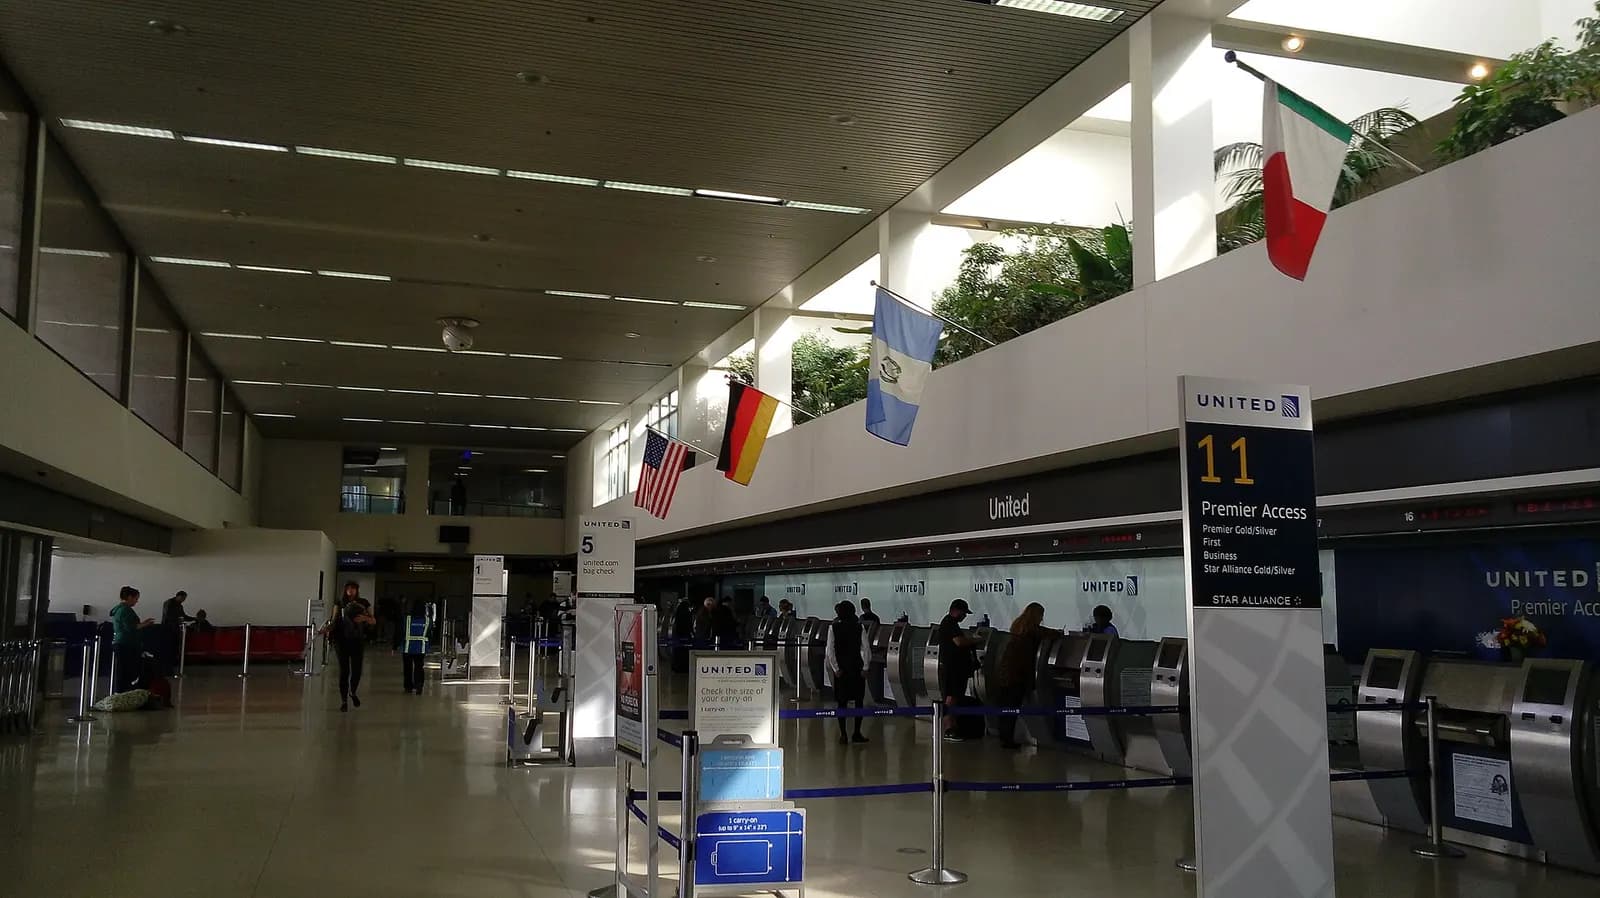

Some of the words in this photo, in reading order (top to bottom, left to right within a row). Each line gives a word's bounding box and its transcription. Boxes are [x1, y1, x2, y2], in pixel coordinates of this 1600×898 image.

[1197, 394, 1276, 412] UNITED
[1198, 434, 1254, 485] 11
[989, 492, 1030, 520] United
[1202, 501, 1257, 518] Premier
[1262, 503, 1307, 520] Access
[1404, 511, 1414, 522] 16
[1202, 524, 1234, 534] Premier
[1235, 525, 1277, 536] Gold/Silver
[582, 536, 594, 554] 5
[1203, 537, 1222, 547] First
[1203, 551, 1238, 560] Business
[1204, 564, 1220, 573] Star
[1222, 565, 1253, 574] Alliance
[1254, 565, 1296, 575] Gold/Silver
[1486, 569, 1589, 588] UNITED
[895, 583, 918, 594] UNITED
[974, 582, 1004, 593] UNITED
[1082, 580, 1124, 593] UNITED
[1212, 595, 1239, 605] STAR
[1242, 596, 1291, 606] ALLIANCE
[1511, 599, 1568, 615] Premier
[701, 666, 752, 674] UNITED
[701, 687, 723, 695] Check
[726, 687, 738, 695] the
[740, 687, 754, 695] size
[756, 687, 764, 695] of
[701, 695, 719, 703] your
[721, 695, 753, 703] carry-on
